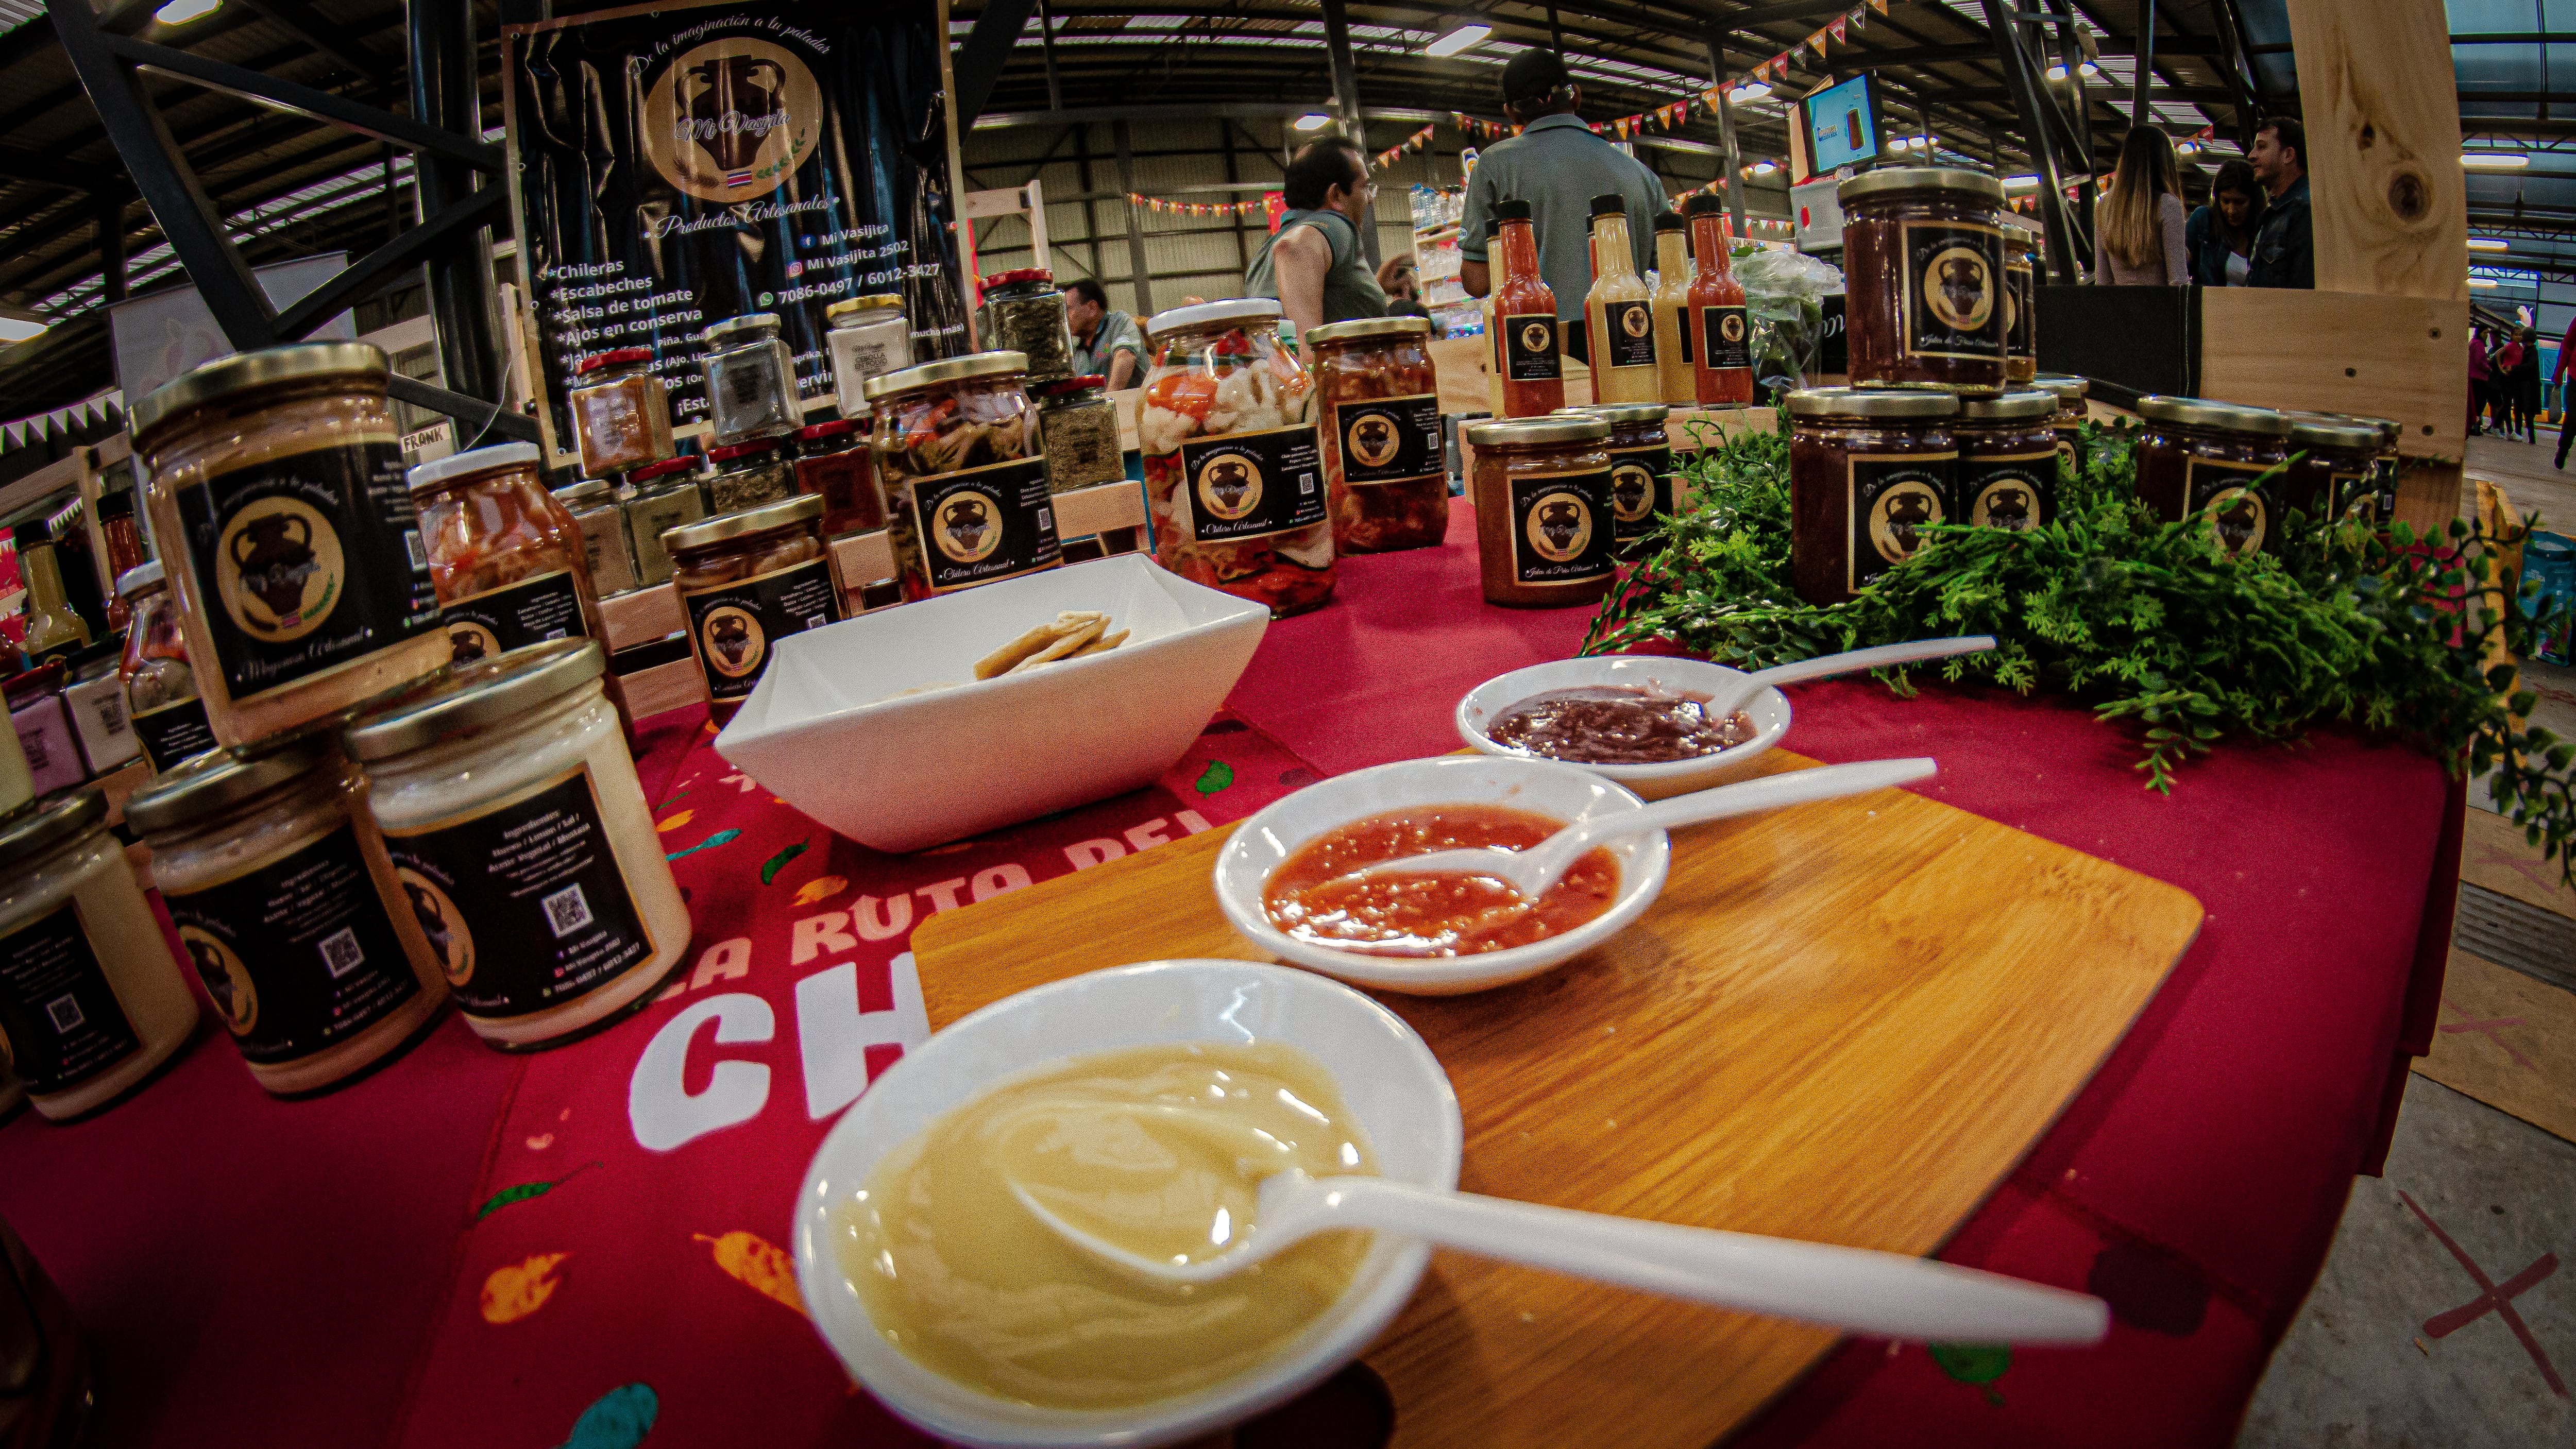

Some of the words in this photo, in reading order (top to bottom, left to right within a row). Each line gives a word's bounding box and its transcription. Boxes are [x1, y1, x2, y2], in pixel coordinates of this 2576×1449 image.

[626, 53, 655, 80] De
[656, 42, 670, 55] la
[673, 13, 750, 45] imaginación
[754, 19, 763, 27] a
[779, 26, 831, 54] paladar
[655, 212, 738, 238] Productos
[744, 194, 830, 223] Artesanales
[822, 234, 837, 246] Mi
[841, 223, 889, 241] Vasijita
[807, 258, 824, 270] Mi
[828, 249, 876, 267] Vasijita
[879, 240, 909, 257] 2502
[778, 277, 853, 305] 7086-0497
[857, 275, 863, 287] /
[867, 263, 940, 286] 6012-3427
[608, 300, 629, 315] de
[633, 288, 693, 311] tomate
[603, 322, 624, 337] en
[629, 309, 703, 332] conserva
[657, 336, 683, 348] Piña,
[404, 428, 444, 451] FRANK
